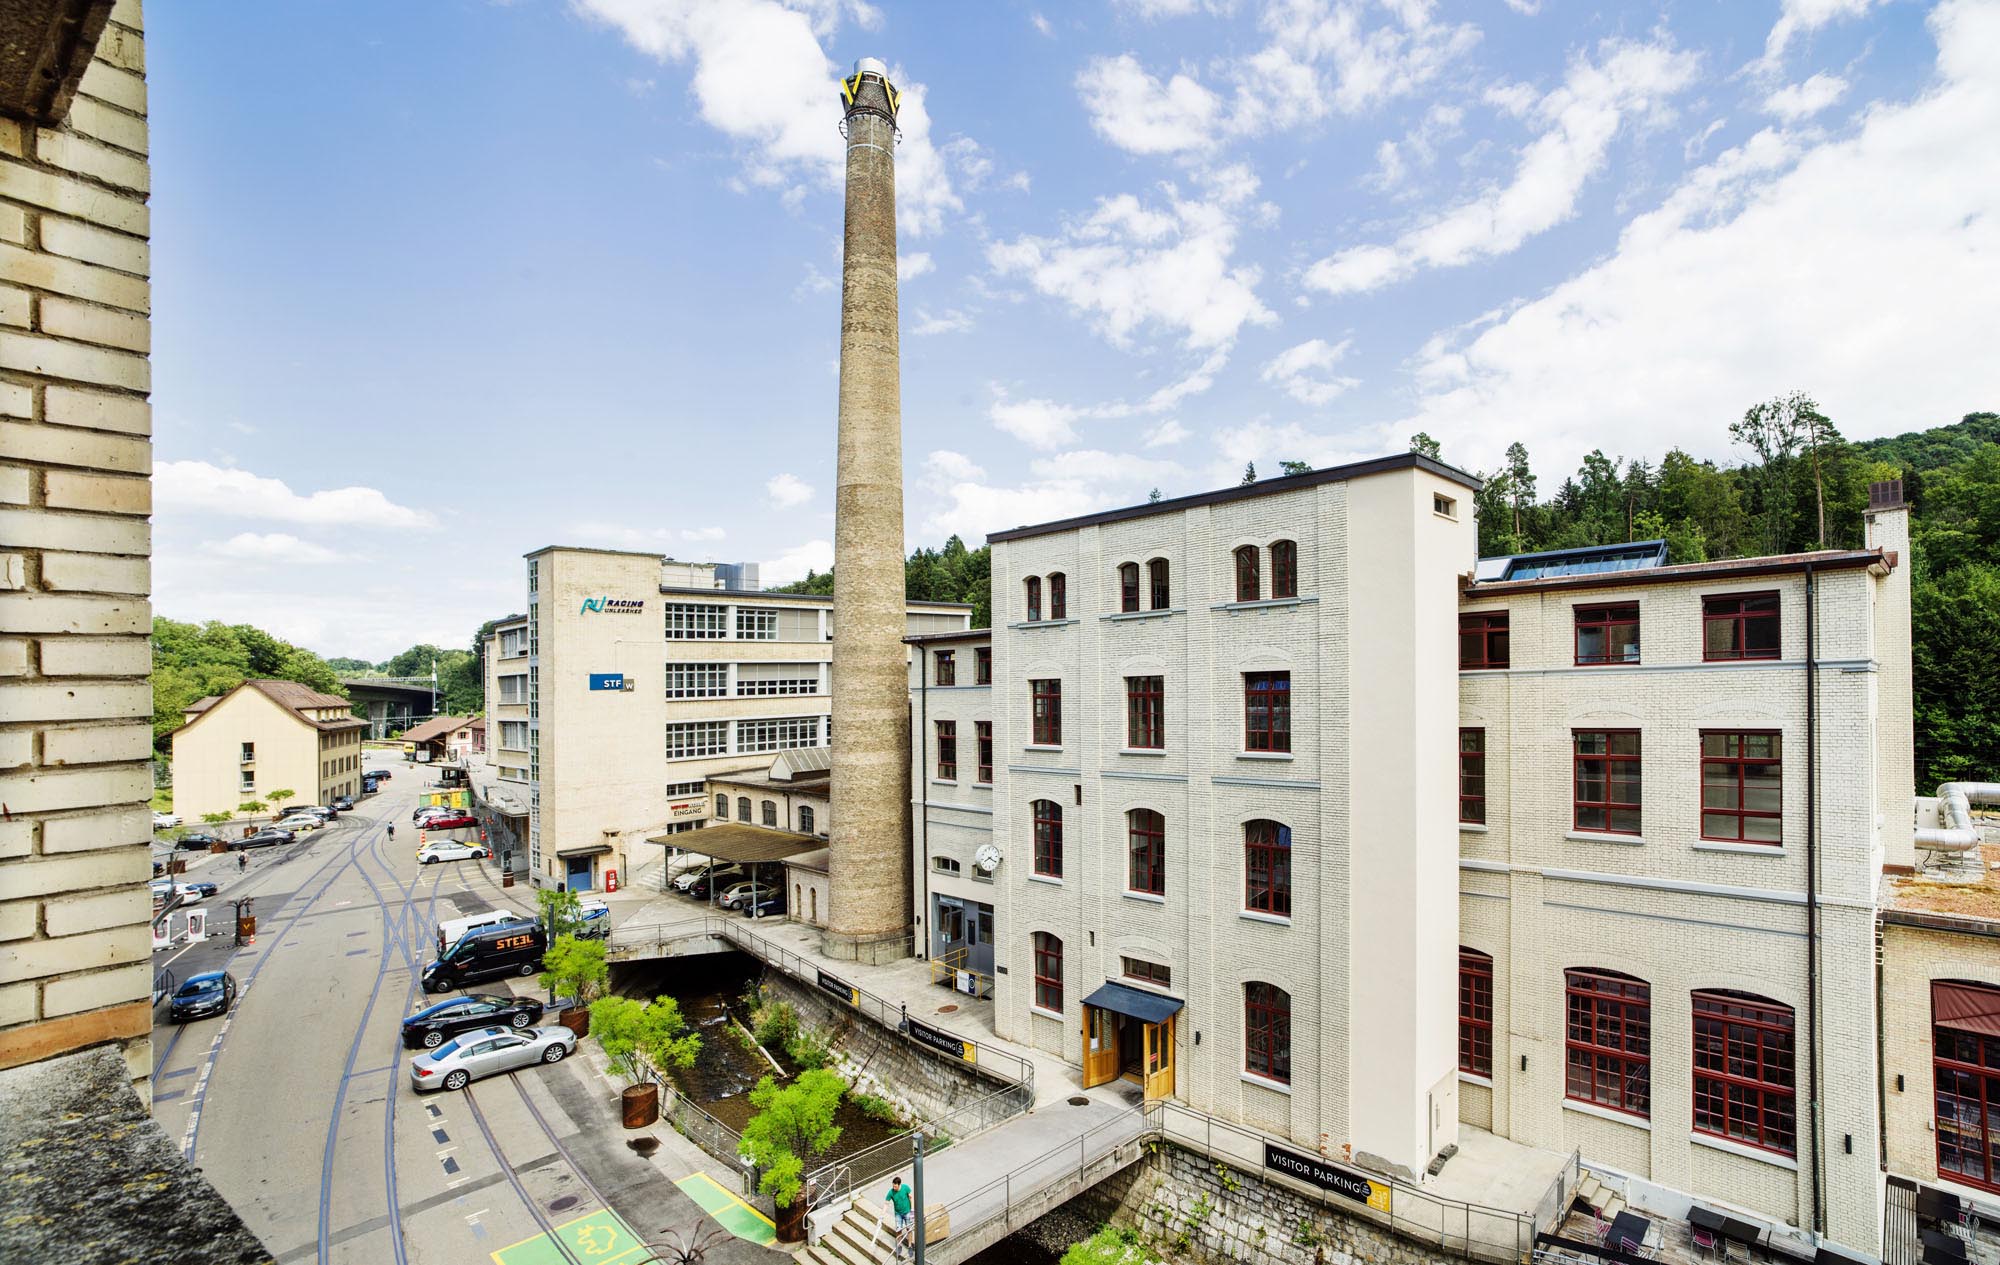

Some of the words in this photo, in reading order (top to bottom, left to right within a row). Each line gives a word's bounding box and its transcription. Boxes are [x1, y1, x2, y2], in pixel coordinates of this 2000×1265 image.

[607, 599, 644, 608] RACING
[603, 679, 622, 688] STF
[673, 807, 702, 817] EINGANG
[914, 1026, 933, 1041] VISITOR
[933, 1035, 956, 1051] PARKING
[1271, 1152, 1310, 1176] VISITOR
[1313, 1167, 1360, 1194] PARKING
